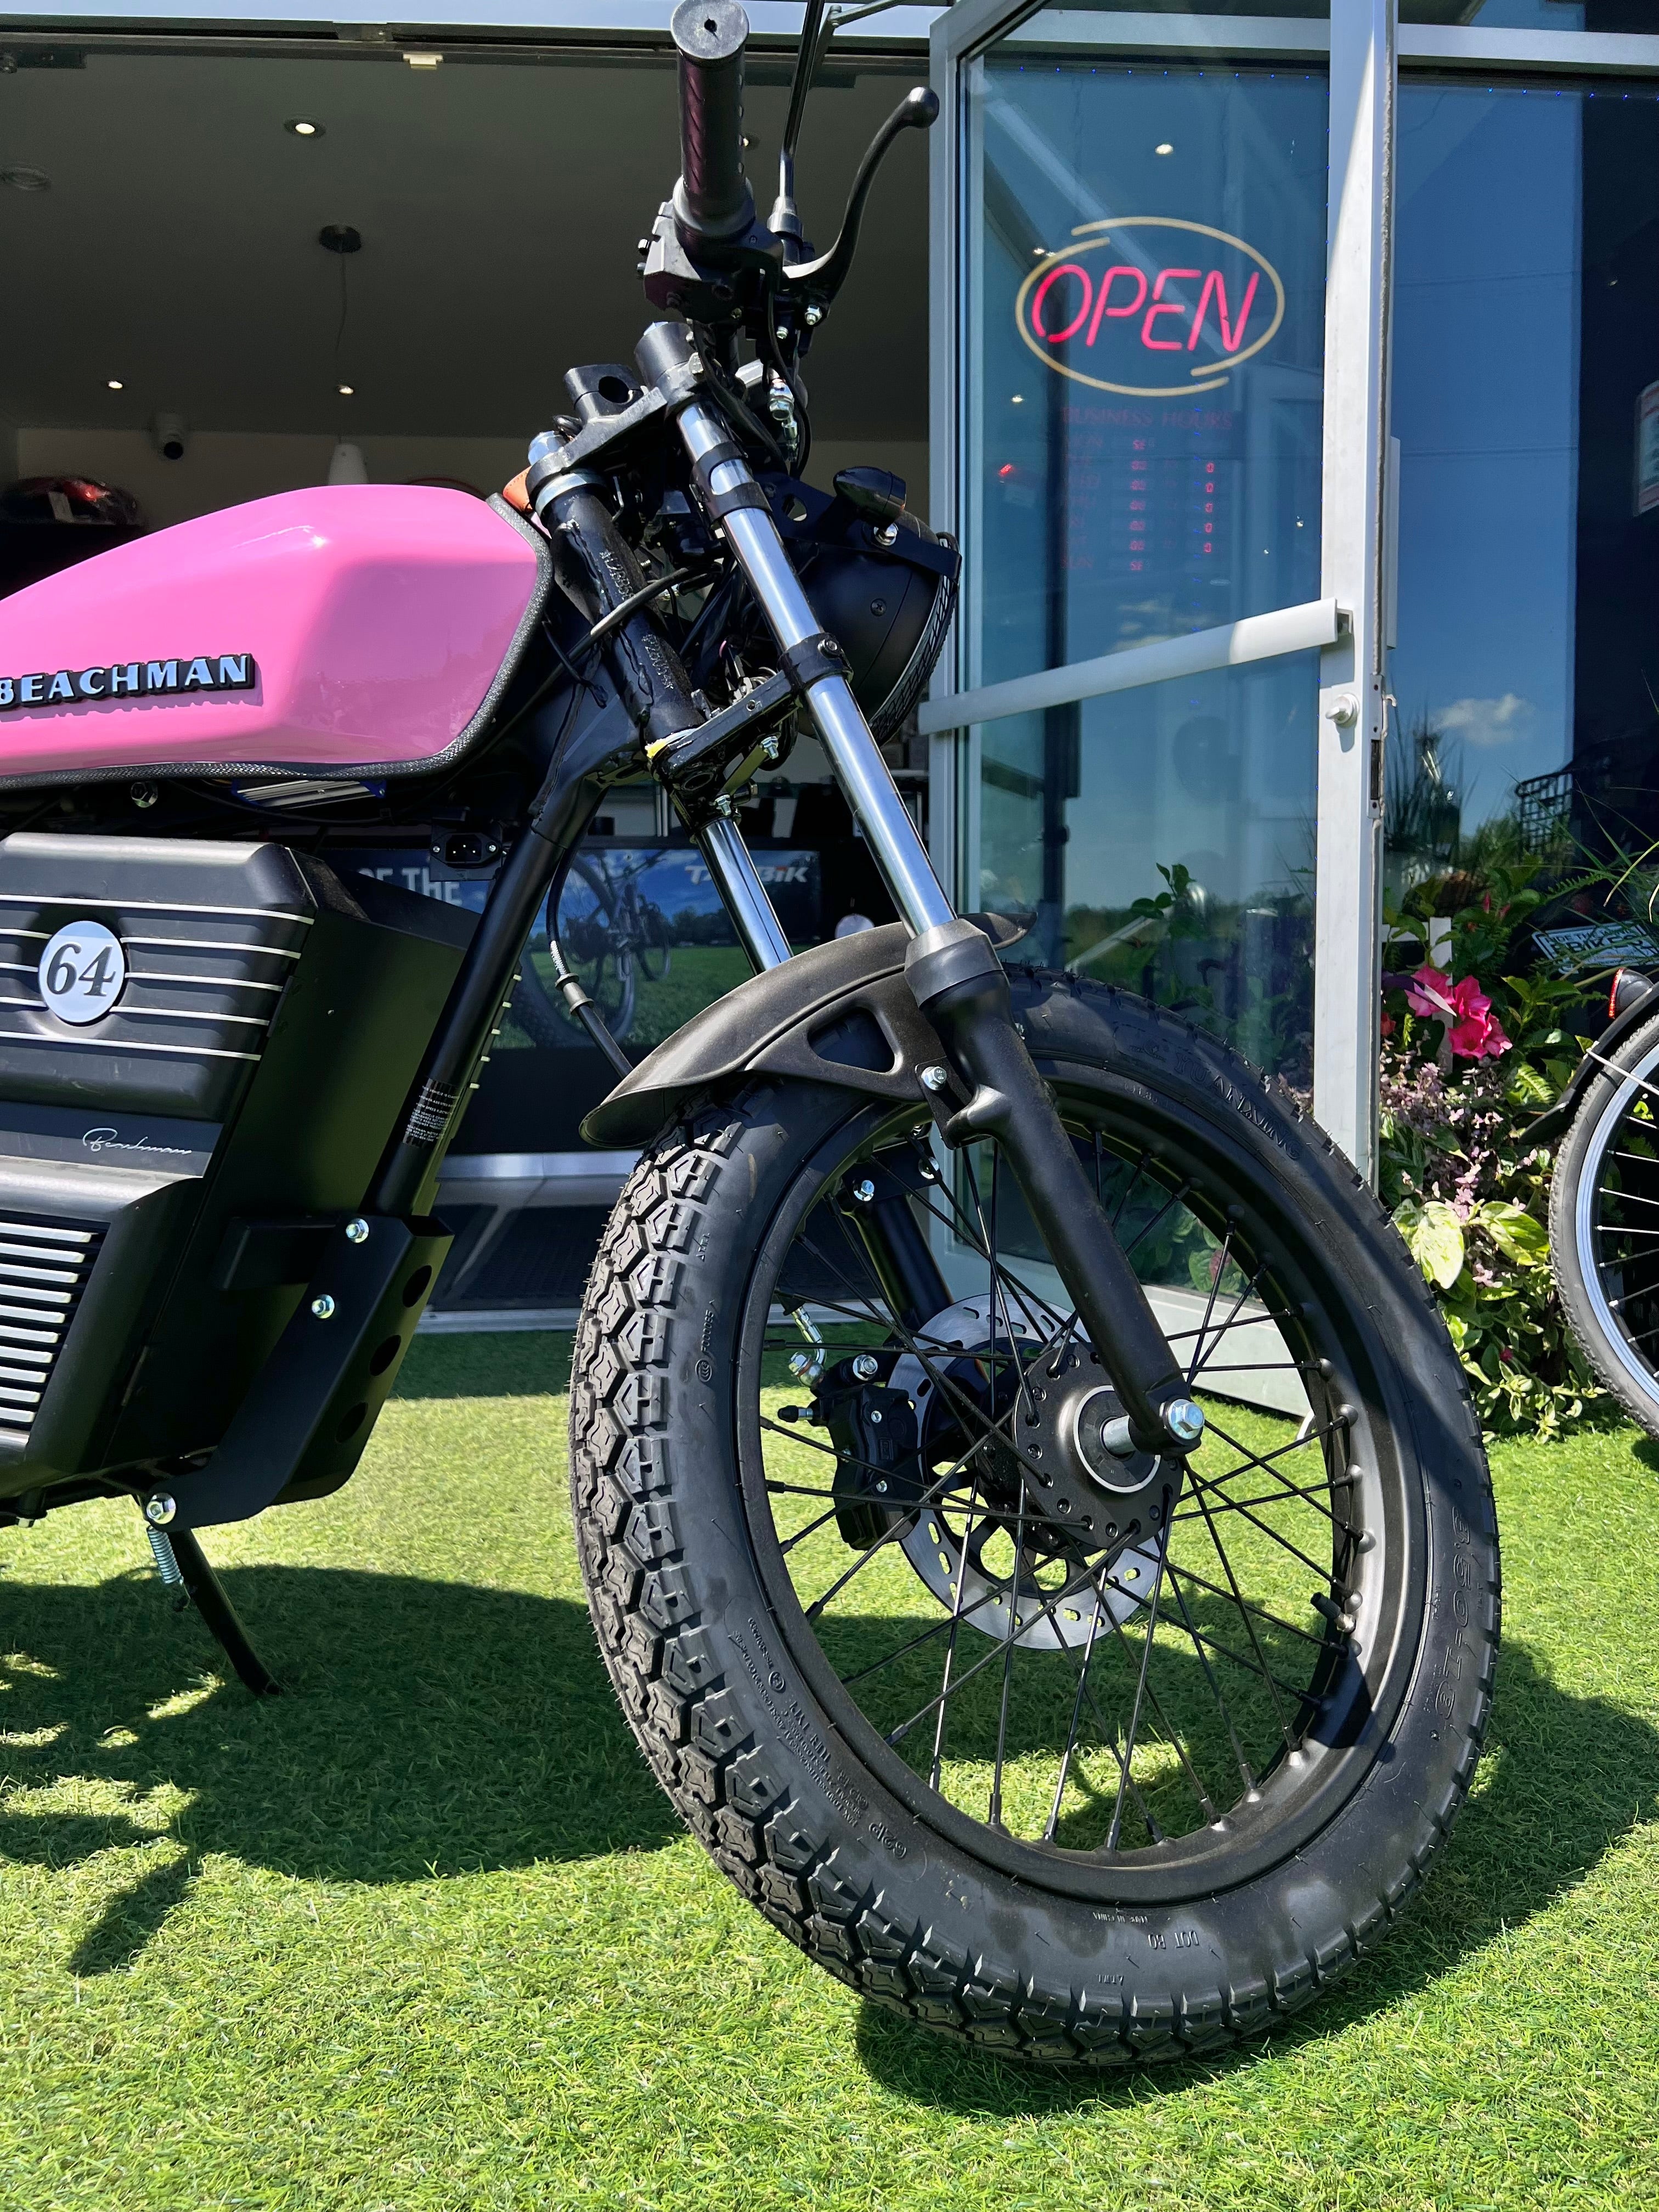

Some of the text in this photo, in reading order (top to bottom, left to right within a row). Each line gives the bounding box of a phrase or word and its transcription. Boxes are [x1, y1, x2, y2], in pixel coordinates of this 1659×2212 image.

[1032, 264, 1260, 352] OPEN
[0, 654, 250, 704] BEACHMAN
[47, 941, 115, 996] 64
[1175, 1053, 1304, 1160] YUANXING
[1175, 1930, 1199, 1949] DOT
